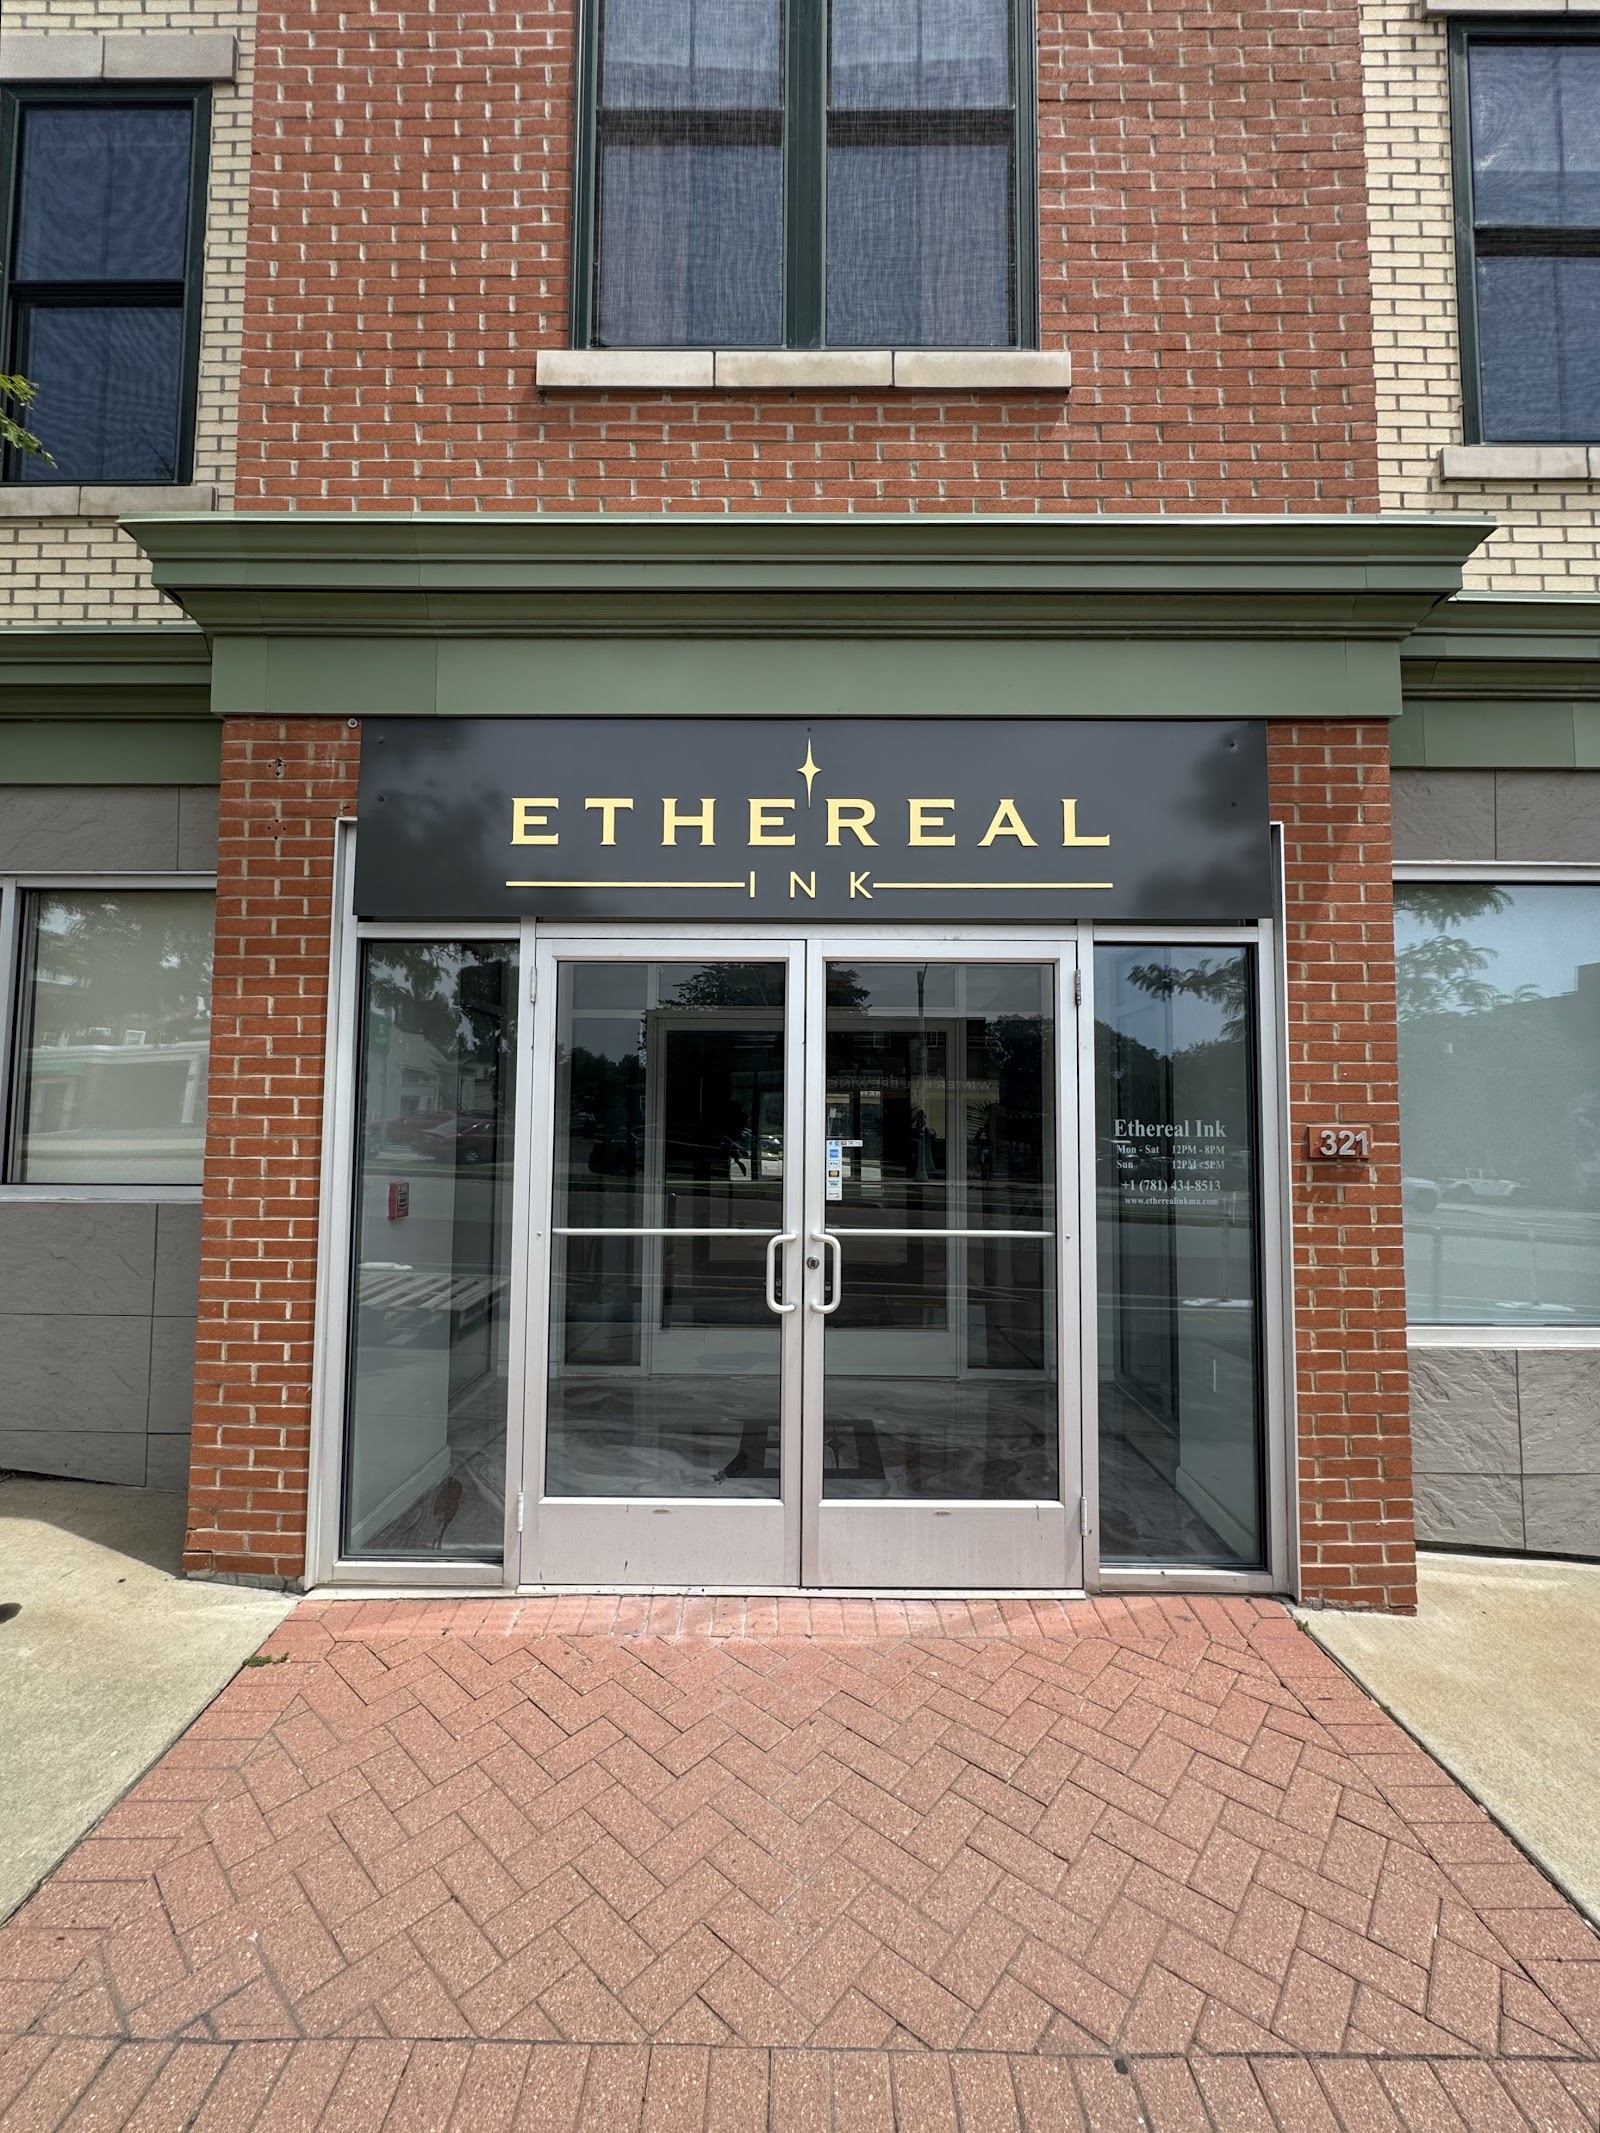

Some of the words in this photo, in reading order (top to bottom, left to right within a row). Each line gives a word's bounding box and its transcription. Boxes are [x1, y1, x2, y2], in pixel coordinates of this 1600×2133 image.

[509, 796, 1111, 847] ETHEREAL
[749, 871, 874, 900] INK
[1113, 1119, 1190, 1138] Ethereal
[1195, 1119, 1227, 1138] Ink
[1116, 1144, 1137, 1154] Mon
[1144, 1144, 1160, 1154] Sat
[1171, 1145, 1197, 1155] 12PM
[1204, 1145, 1225, 1155] 8PM
[1320, 1130, 1369, 1156] 321
[1116, 1160, 1134, 1169] Sun
[1171, 1160, 1197, 1170] 12PM
[1204, 1160, 1225, 1170] 5PM
[1121, 1180, 1135, 1191] +1
[1139, 1179, 1168, 1194] (781)
[1170, 1180, 1221, 1192] 434-8513
[1124, 1197, 1219, 1205] www.etherealinkma.com
